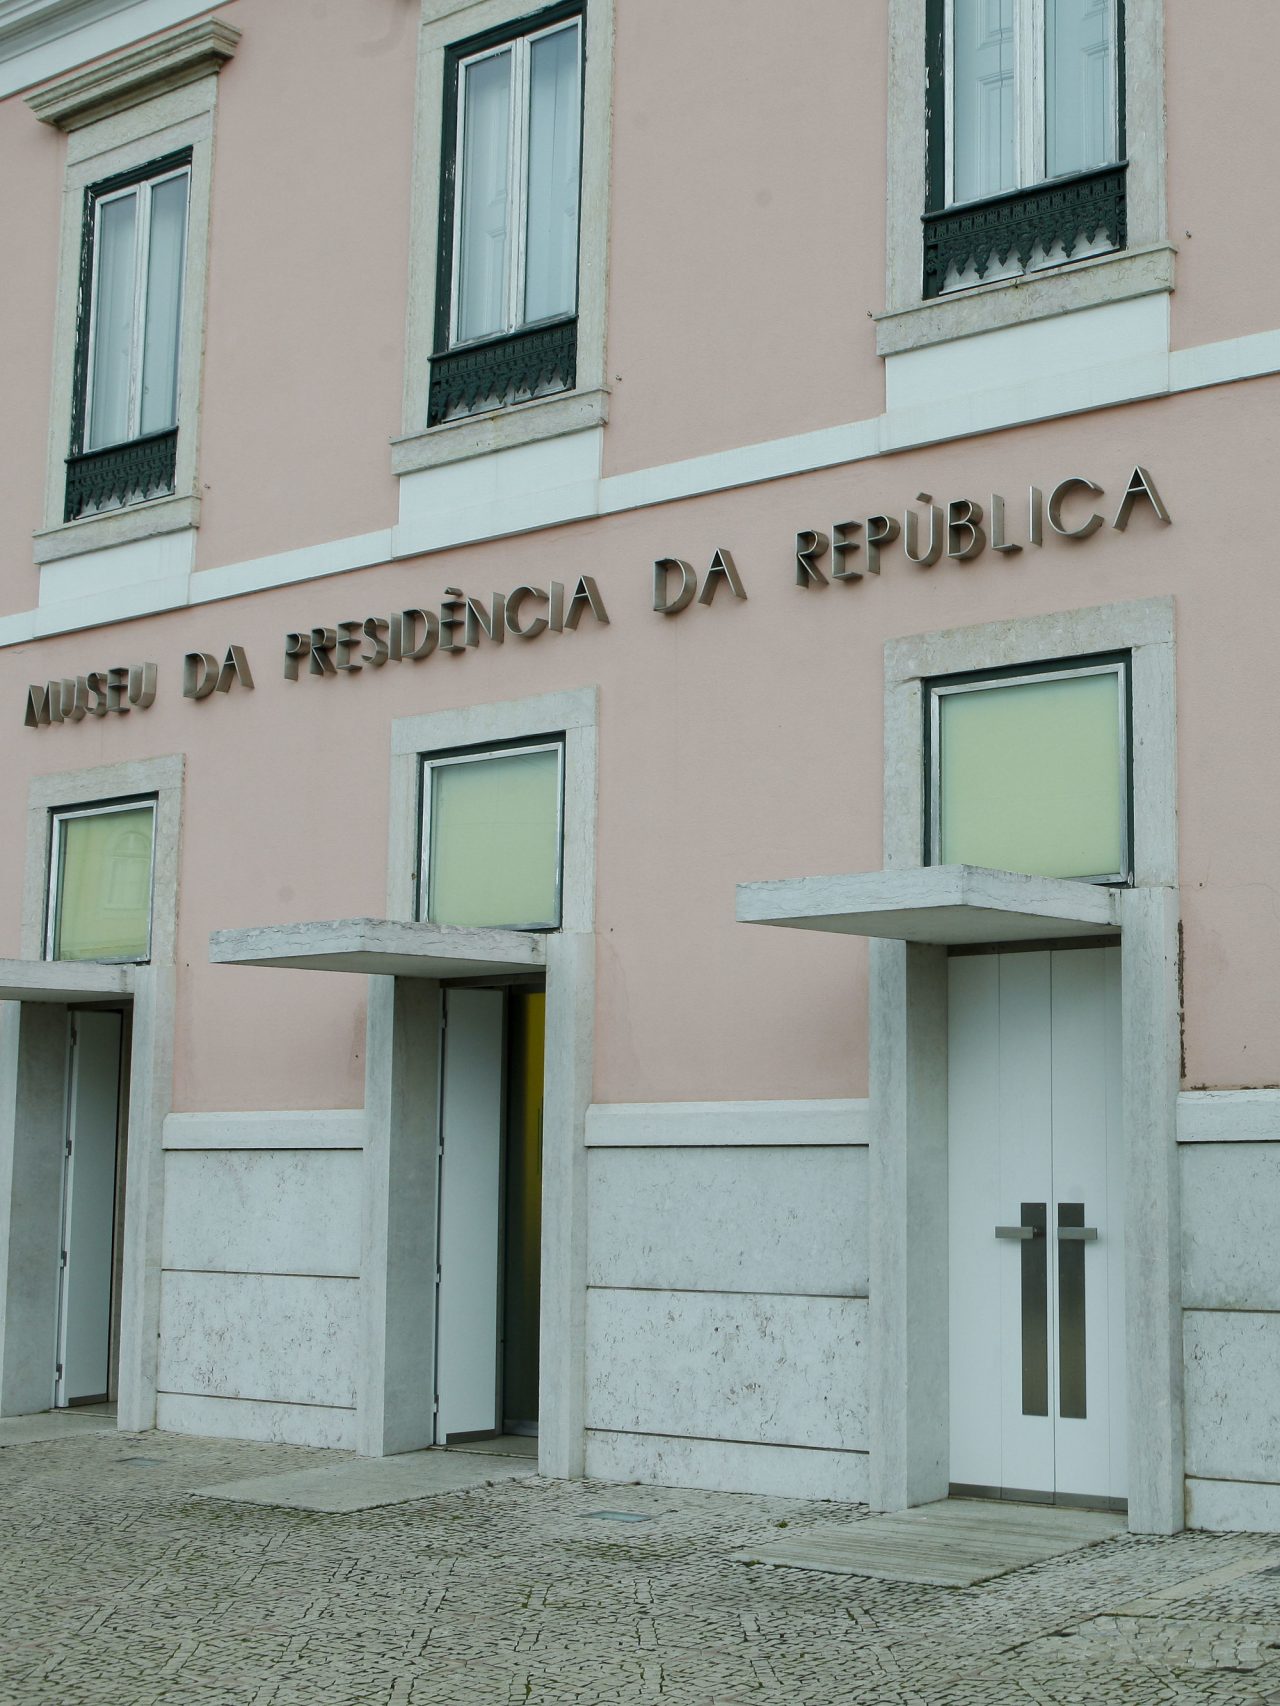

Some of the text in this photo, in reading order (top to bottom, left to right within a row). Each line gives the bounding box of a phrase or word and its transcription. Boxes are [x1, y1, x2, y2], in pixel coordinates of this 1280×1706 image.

[24, 661, 158, 728] MUSEU
[182, 644, 255, 700] DA
[653, 547, 748, 615] DA
